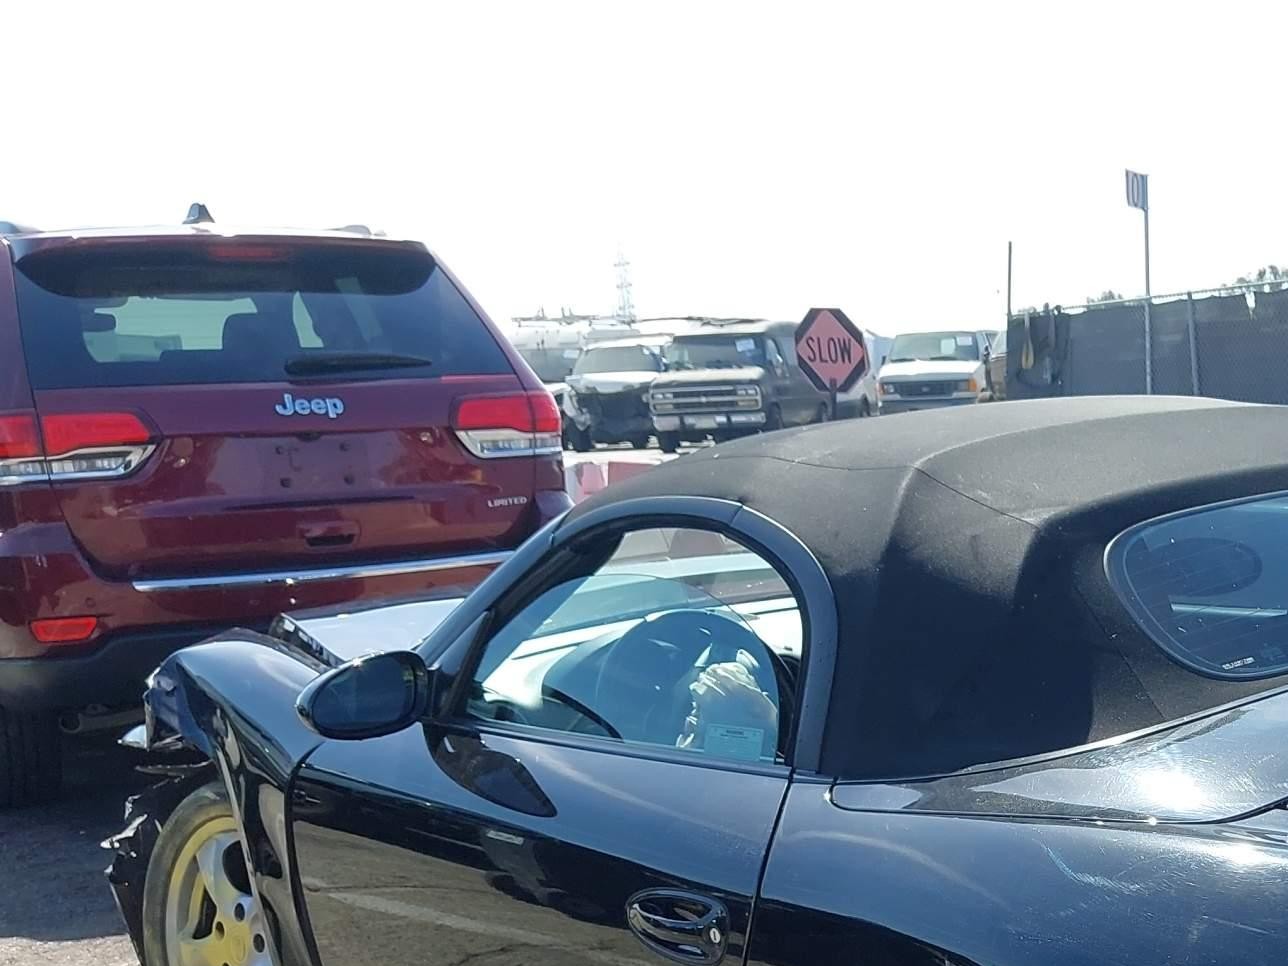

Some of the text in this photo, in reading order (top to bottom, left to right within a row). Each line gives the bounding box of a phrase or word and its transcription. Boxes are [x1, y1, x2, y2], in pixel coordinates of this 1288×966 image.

[806, 336, 852, 364] SLOW
[275, 393, 344, 418] Jeep
[487, 496, 528, 508] LIMITED
